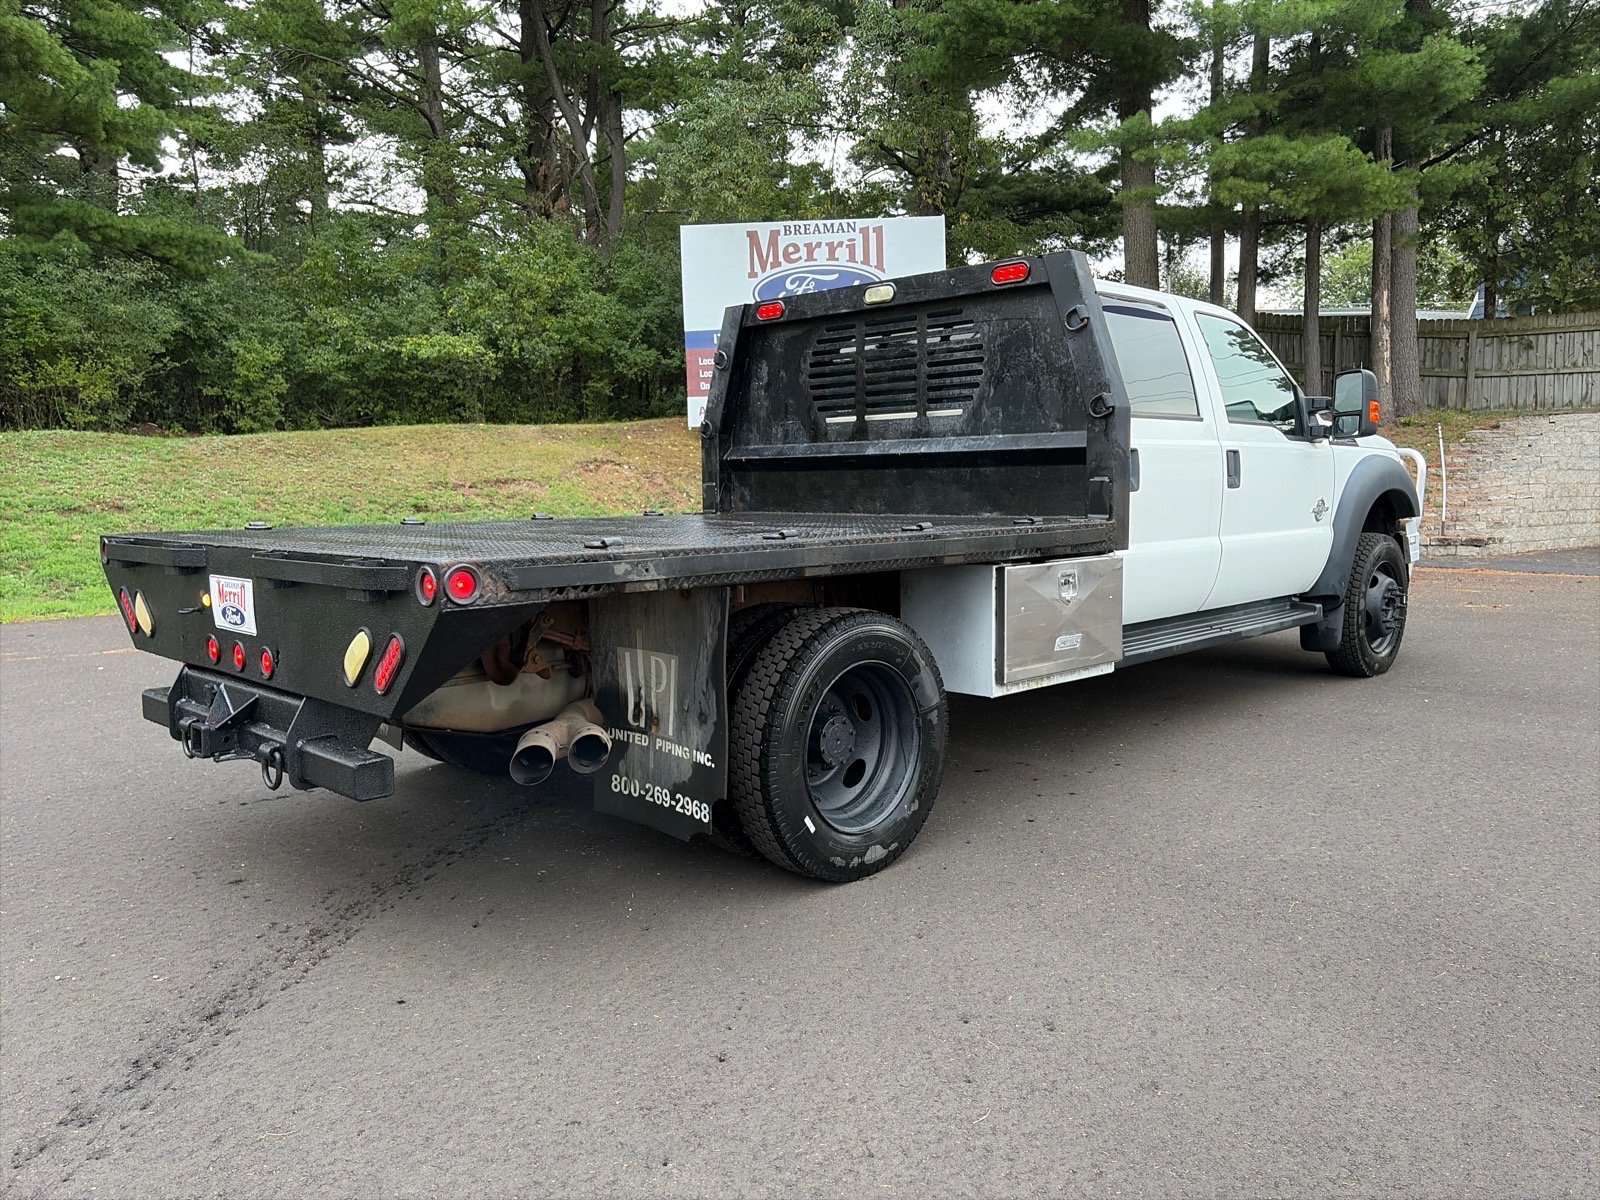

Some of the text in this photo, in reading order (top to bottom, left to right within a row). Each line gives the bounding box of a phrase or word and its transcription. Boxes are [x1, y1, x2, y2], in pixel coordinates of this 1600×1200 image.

[783, 222, 856, 236] BREAMAN
[746, 225, 885, 278] Merrill
[217, 581, 246, 612] Merrill
[225, 606, 242, 624] Ford
[607, 727, 716, 769] UNITED PIPING INC.
[611, 773, 710, 824] 800-269-2968
